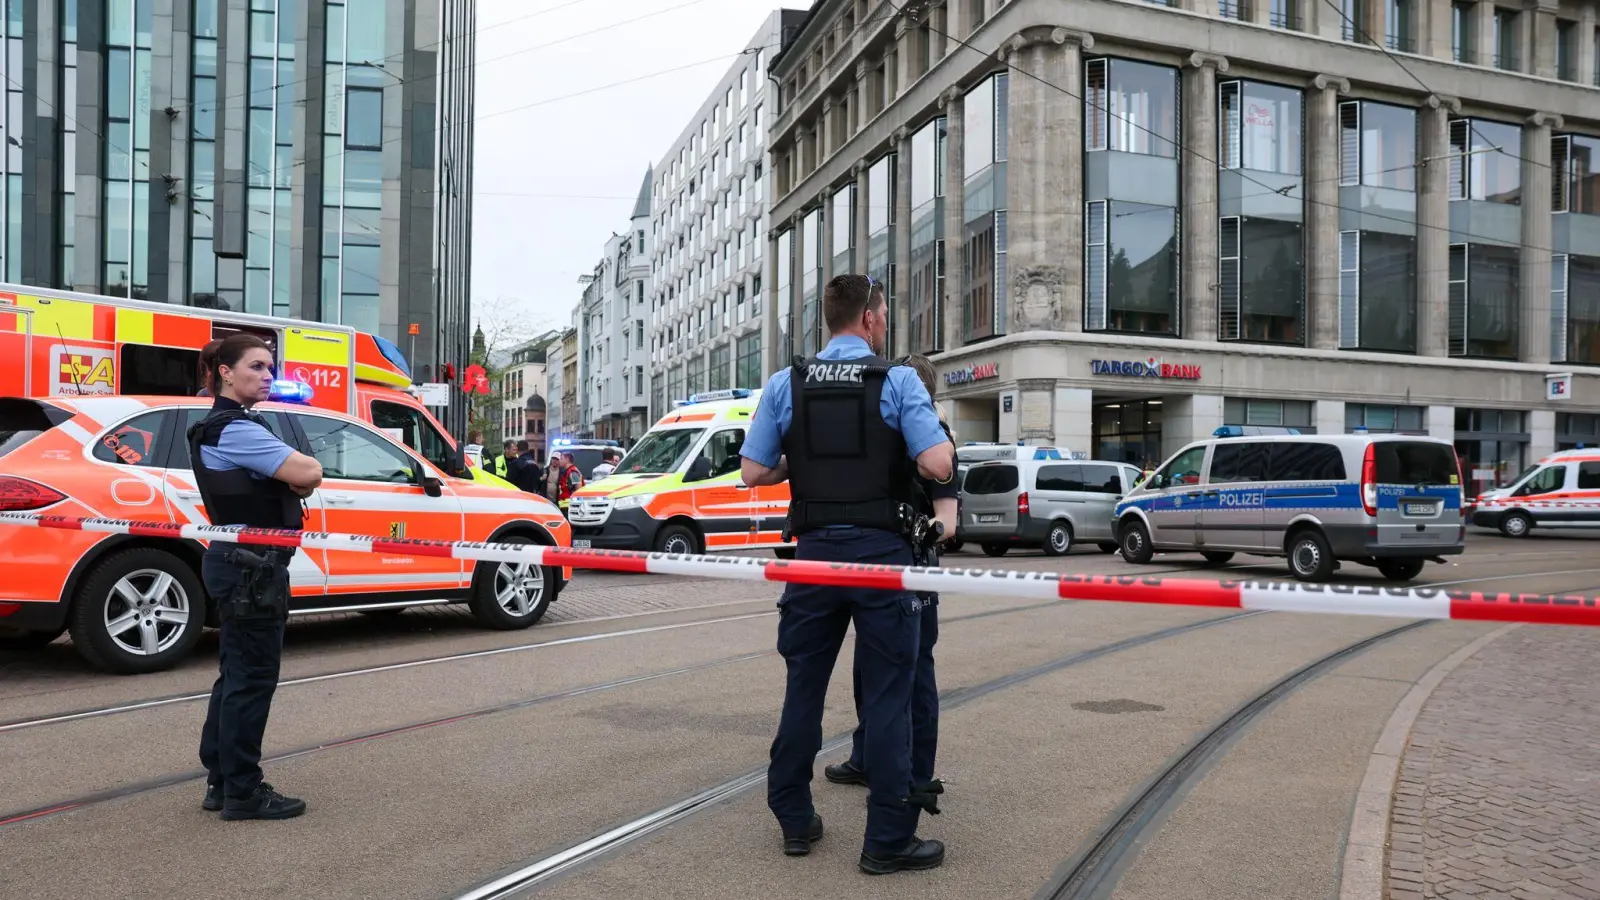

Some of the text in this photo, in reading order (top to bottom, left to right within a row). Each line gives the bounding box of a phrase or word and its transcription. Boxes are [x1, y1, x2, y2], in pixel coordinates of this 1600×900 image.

[312, 368, 341, 388] 112
[116, 444, 143, 465] 112
[1219, 492, 1264, 507] POLIZEI
[1379, 487, 1406, 497] POLIZEI
